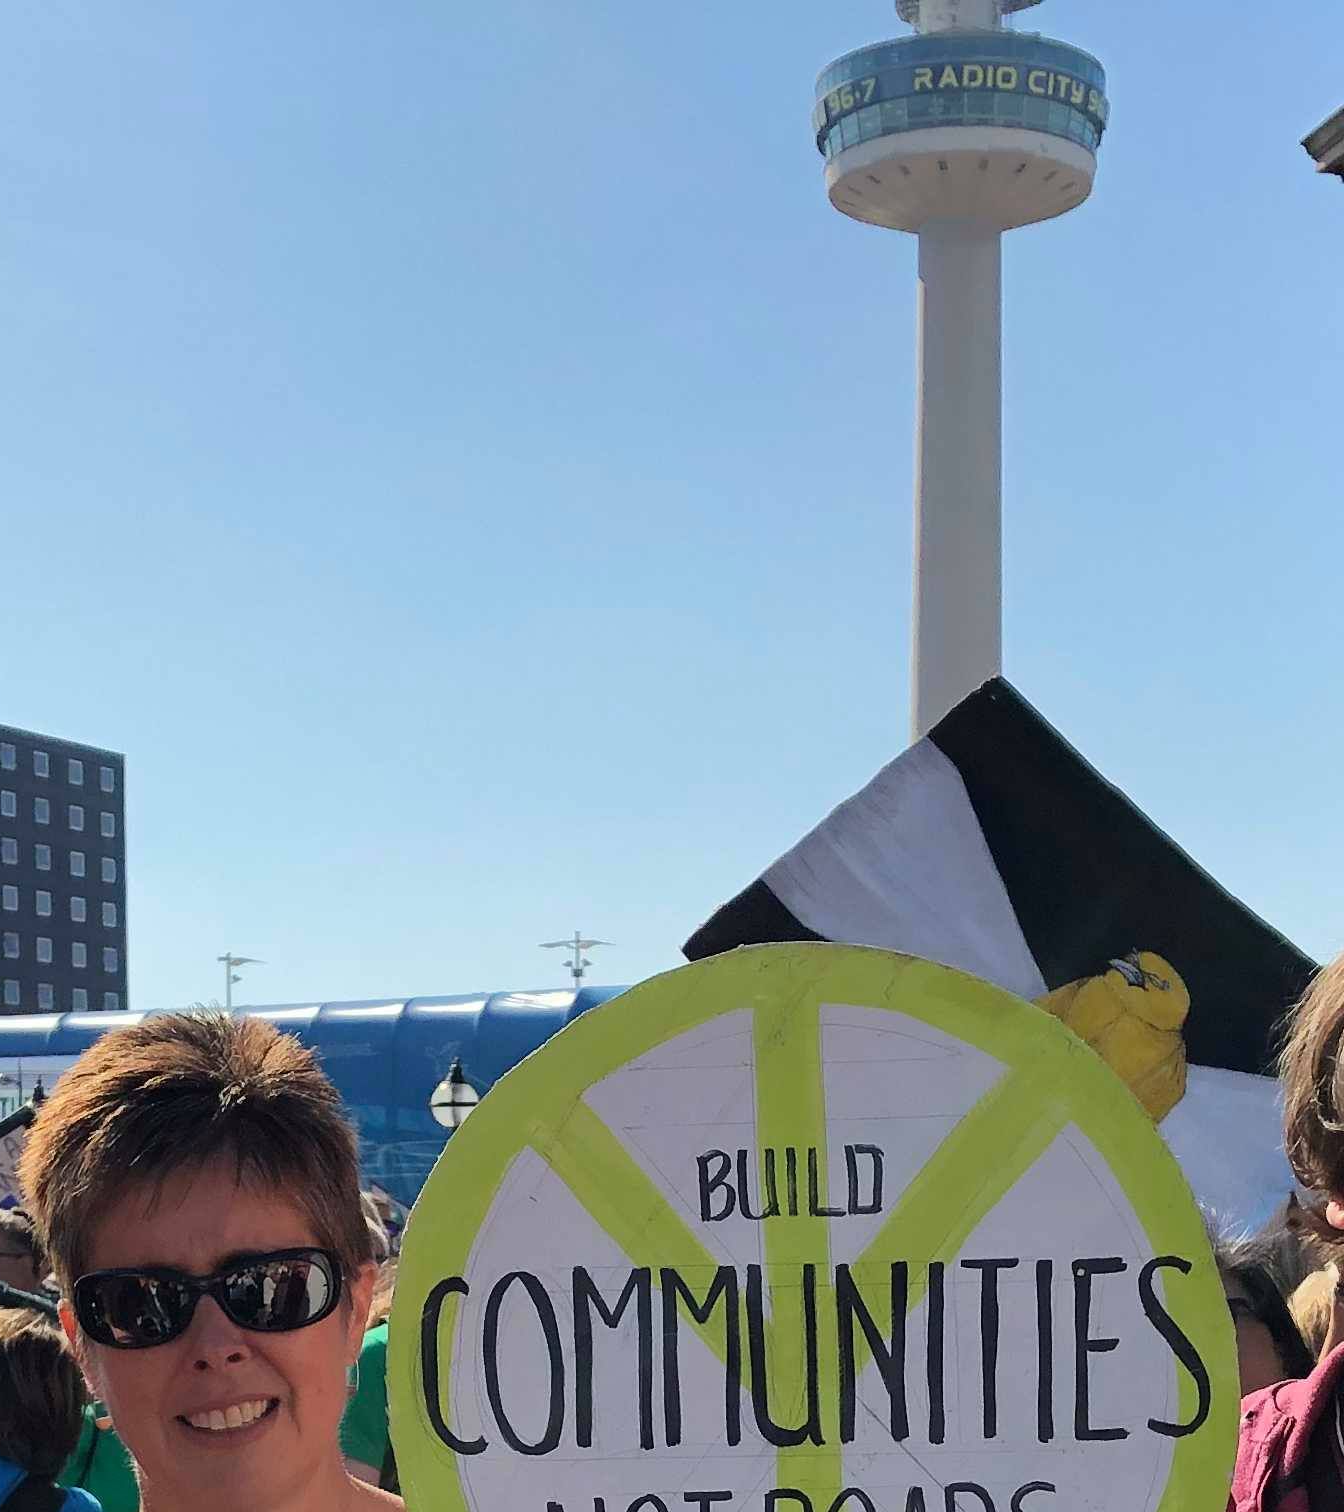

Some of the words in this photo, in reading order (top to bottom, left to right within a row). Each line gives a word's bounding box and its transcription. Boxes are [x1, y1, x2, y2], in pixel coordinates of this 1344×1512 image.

[913, 64, 1017, 92] RADIO
[1027, 69, 1086, 105] CITY
[697, 1143, 884, 1222] BUILD
[421, 1255, 1212, 1456] COMMUNITIES
